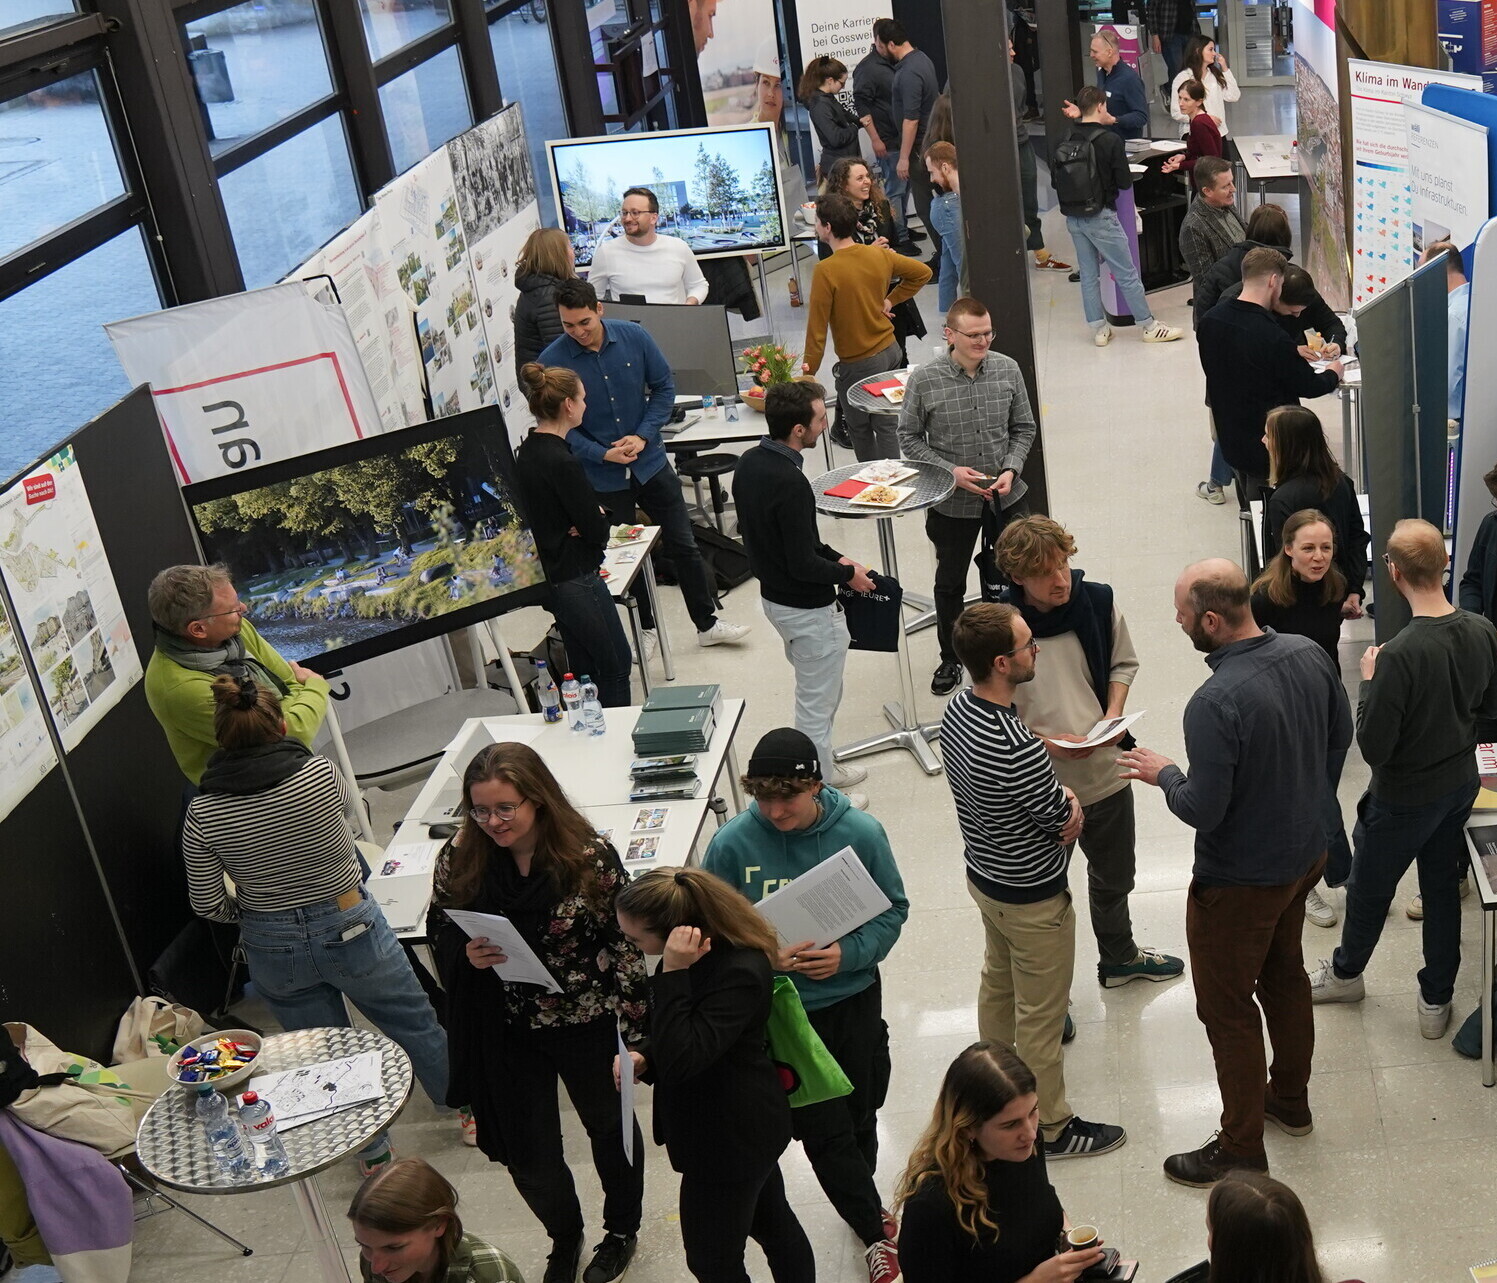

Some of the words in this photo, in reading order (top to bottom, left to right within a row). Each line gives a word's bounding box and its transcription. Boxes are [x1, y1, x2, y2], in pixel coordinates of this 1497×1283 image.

[811, 21, 840, 34] Deine
[813, 36, 828, 48] bei
[830, 29, 873, 45] Gosswei
[1355, 71, 1383, 86] Klima
[1386, 75, 1399, 88] im
[1402, 77, 1431, 91] Wand
[1420, 171, 1433, 184] uns
[1434, 174, 1453, 192] planst
